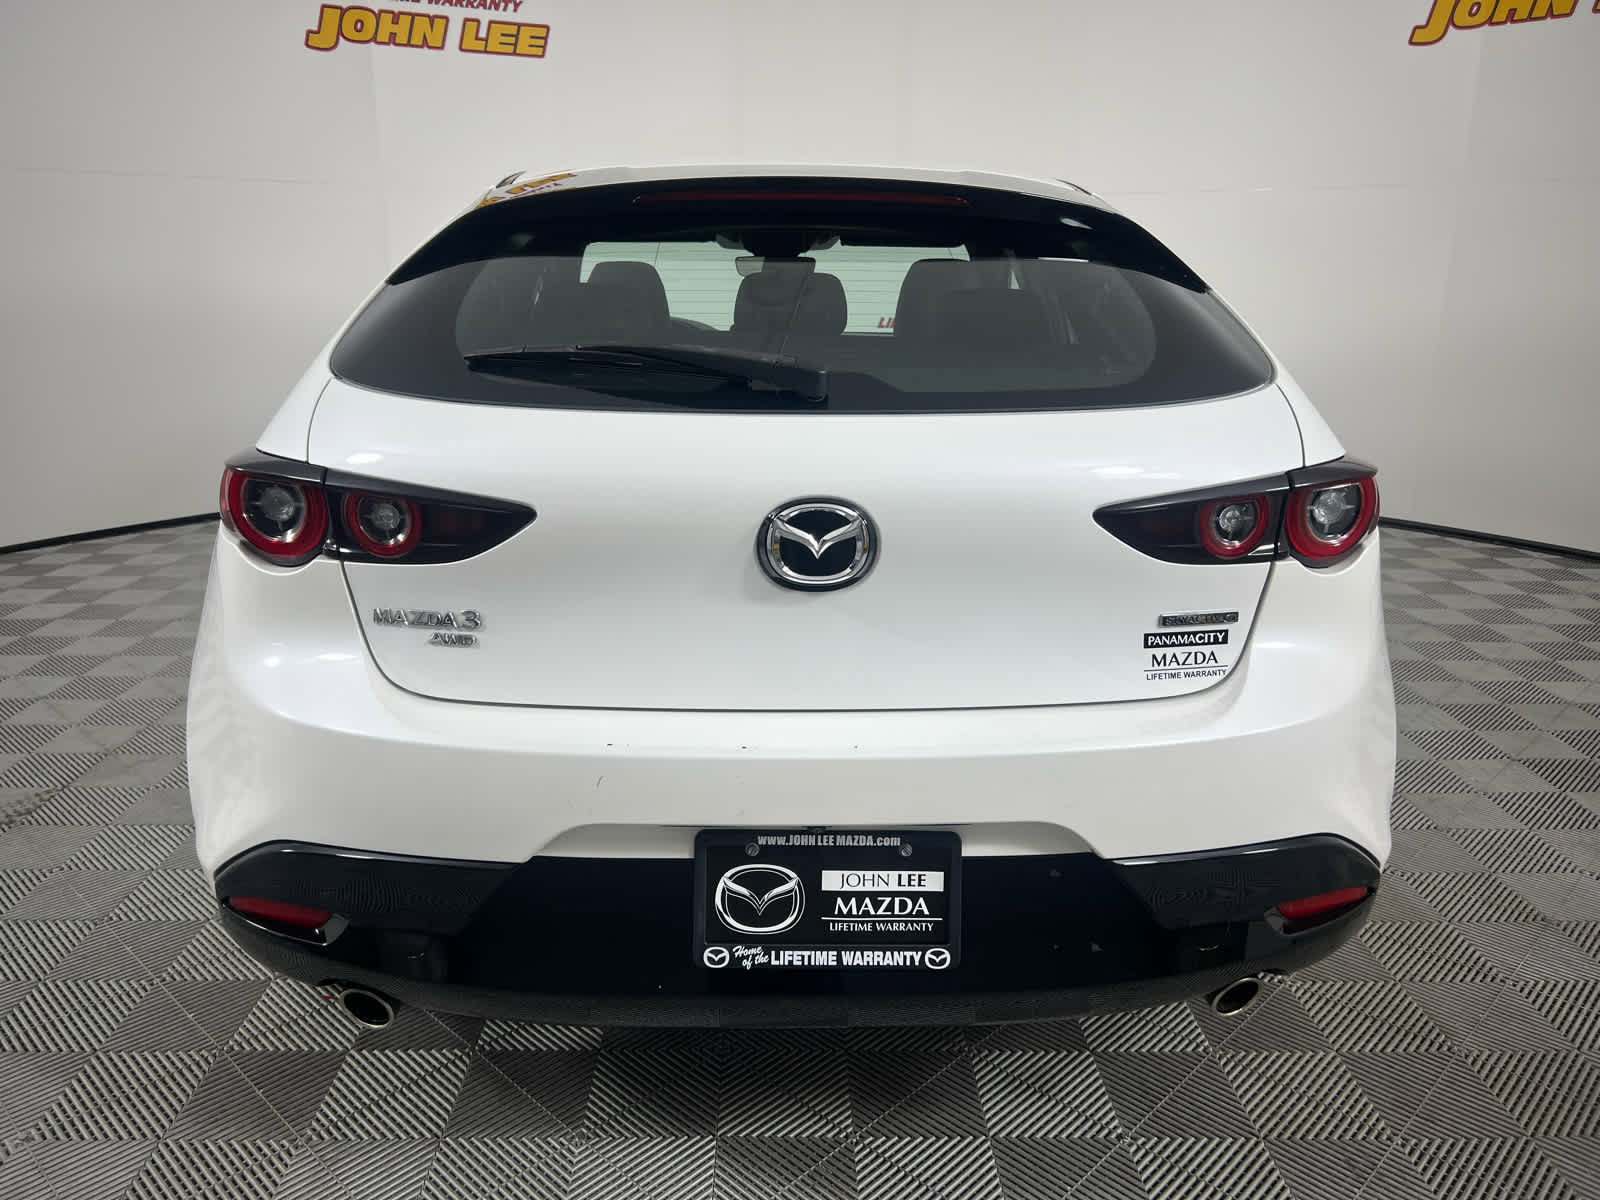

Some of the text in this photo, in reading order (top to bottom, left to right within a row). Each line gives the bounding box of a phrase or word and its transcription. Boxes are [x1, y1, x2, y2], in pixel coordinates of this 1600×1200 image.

[305, 4, 550, 58] JOHN LEE
[429, 632, 477, 648] AWD
[1152, 650, 1218, 667] MAZDA
[1146, 669, 1227, 680] LIFETIME WARRANTY
[840, 873, 927, 889] JOHN LEE
[834, 897, 930, 915] MAZDA
[829, 922, 934, 932] LIFETIME WARRANTY
[732, 945, 762, 958] Home
[770, 950, 922, 966] LIFETIME WARRANTY
[742, 952, 769, 970] of the
